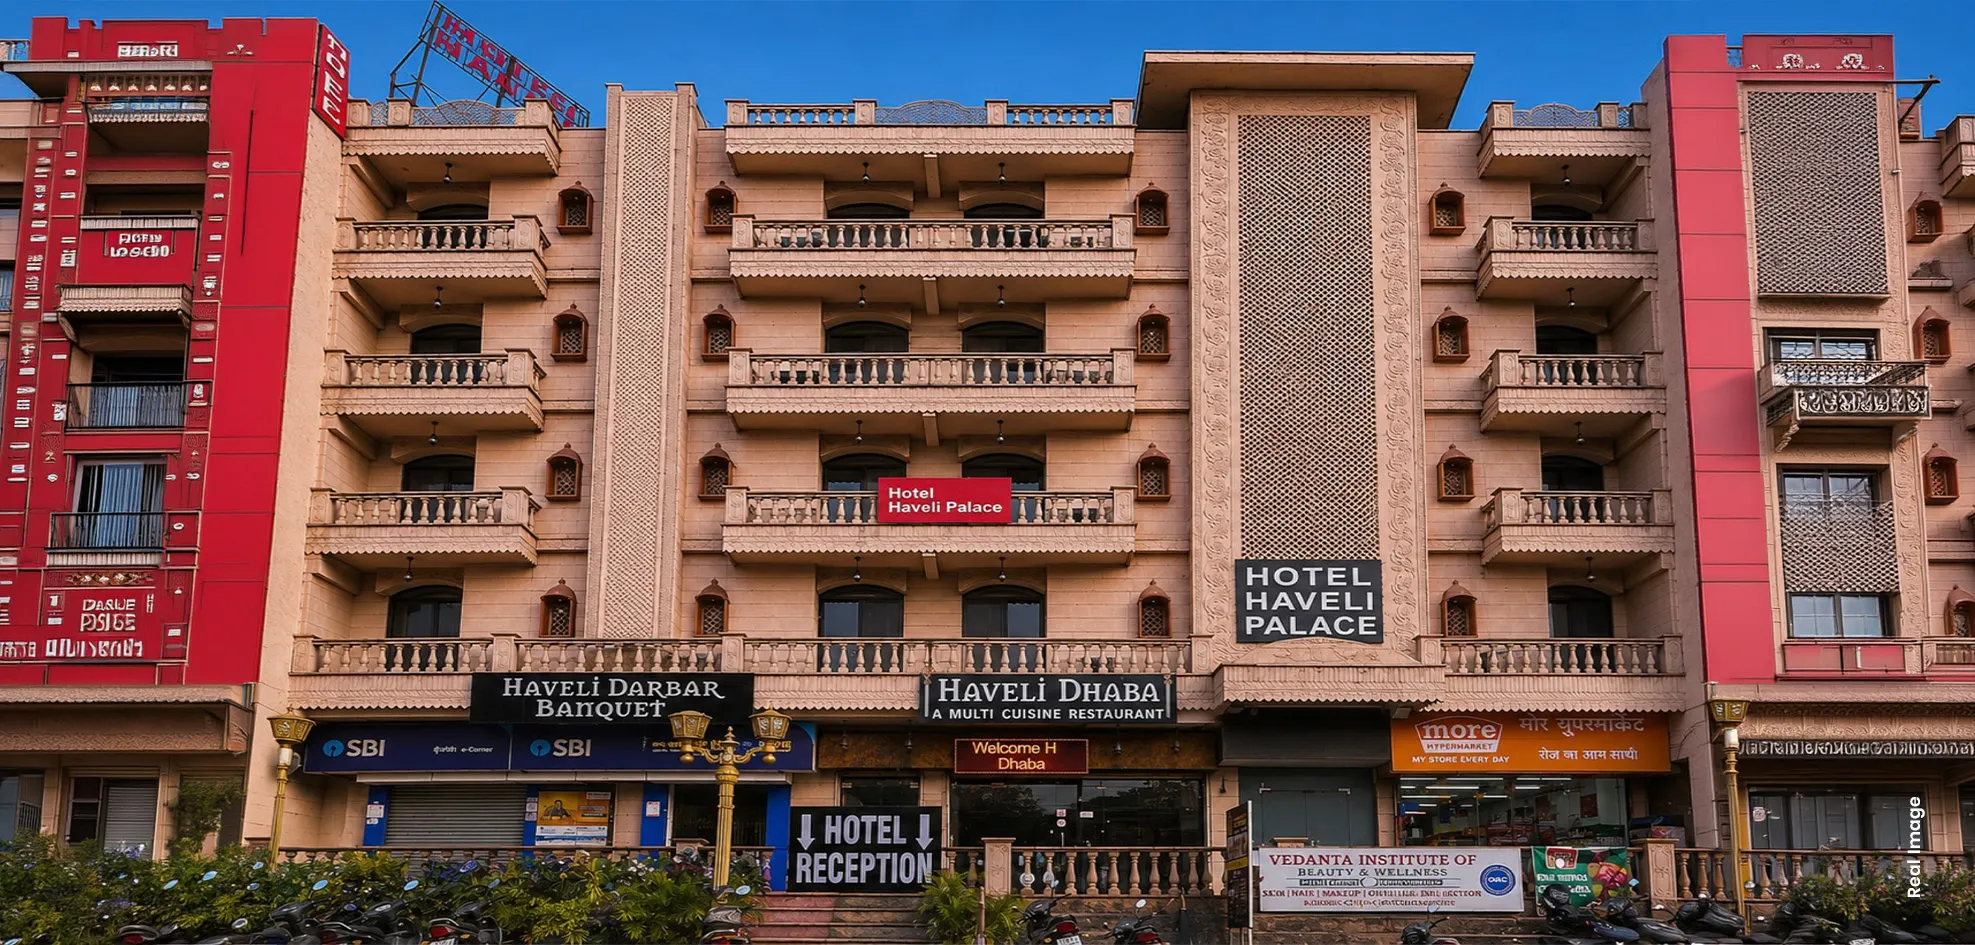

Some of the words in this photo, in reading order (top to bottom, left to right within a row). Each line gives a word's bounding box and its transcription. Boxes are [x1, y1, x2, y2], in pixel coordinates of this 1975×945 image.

[888, 487, 934, 499] Hotel
[888, 501, 941, 513] Haveli
[946, 501, 1003, 513] Palace
[1246, 567, 1372, 586] HOTEL
[1246, 591, 1374, 611] HAVELI
[1245, 616, 1377, 635] PALACE
[608, 678, 726, 699] DARBAR
[1058, 678, 1160, 702] DHABA
[932, 709, 942, 719] A
[950, 709, 994, 719] MULTI
[1001, 708, 1062, 719] CUISINE
[1069, 709, 1164, 719] RESTAURANT
[1422, 724, 1496, 739] more
[345, 739, 385, 757] SBI
[553, 738, 591, 757] SBI
[972, 741, 1040, 754] Welcome
[1045, 742, 1057, 754] H
[998, 757, 1045, 770] Dhaba
[824, 815, 907, 845] HOTEL
[796, 852, 933, 884] RECEPTION
[1269, 854, 1353, 866] VEDANTA
[1358, 854, 1449, 866] INSTITUTE
[1454, 854, 1477, 866] OF
[1297, 868, 1354, 877] BEAUTY
[1359, 868, 1369, 877] &
[1374, 868, 1448, 877] WELLNESS
